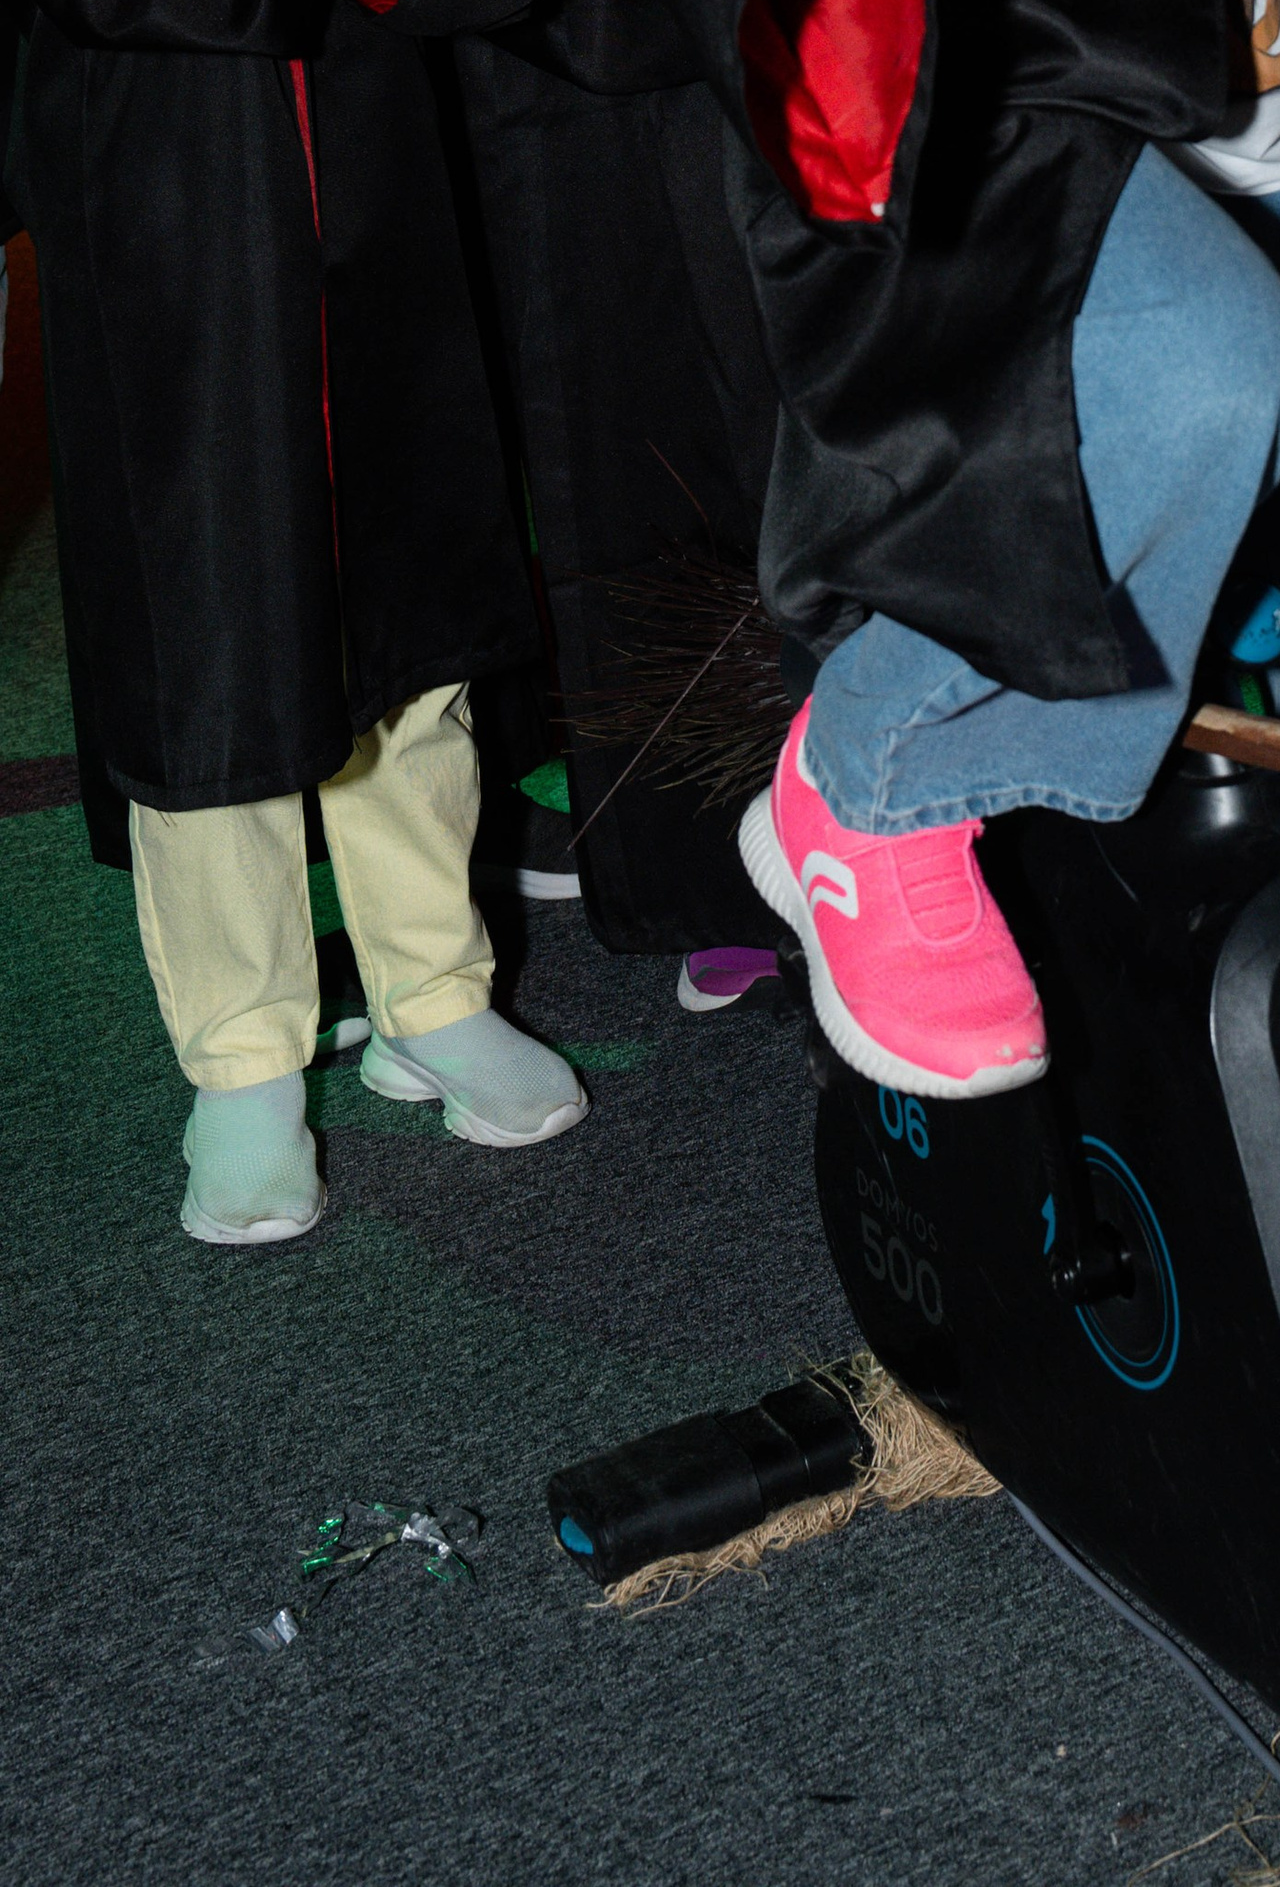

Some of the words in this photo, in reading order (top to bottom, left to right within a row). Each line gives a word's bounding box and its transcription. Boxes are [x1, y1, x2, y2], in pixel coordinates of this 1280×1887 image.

[878, 1084, 931, 1160] 06
[856, 1166, 938, 1252] DOMYOS
[860, 1211, 943, 1325] 500
